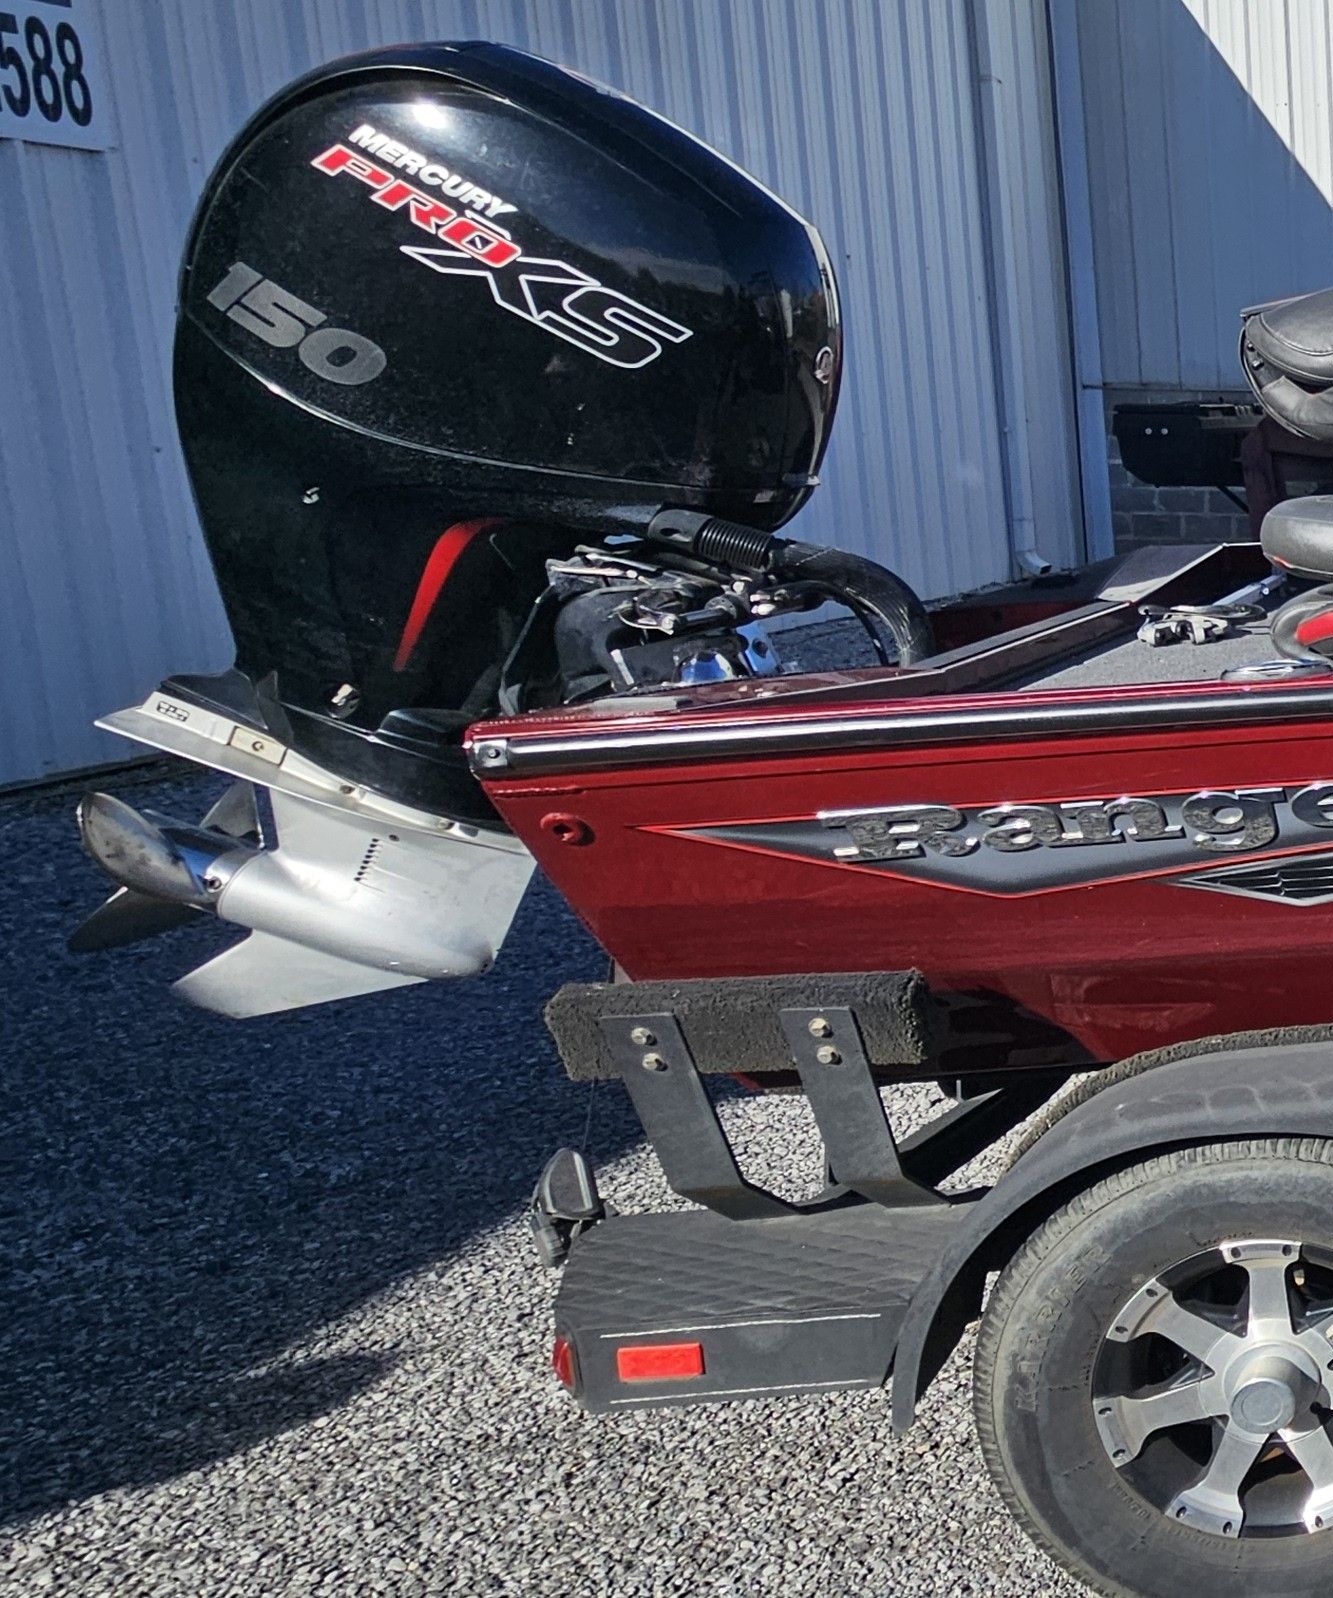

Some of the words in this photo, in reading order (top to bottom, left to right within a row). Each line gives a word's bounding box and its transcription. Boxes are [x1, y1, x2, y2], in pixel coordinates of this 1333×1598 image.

[310, 143, 522, 268] PRO
[348, 123, 519, 219] MERCURY
[206, 261, 388, 386] 150
[400, 244, 694, 369] XS
